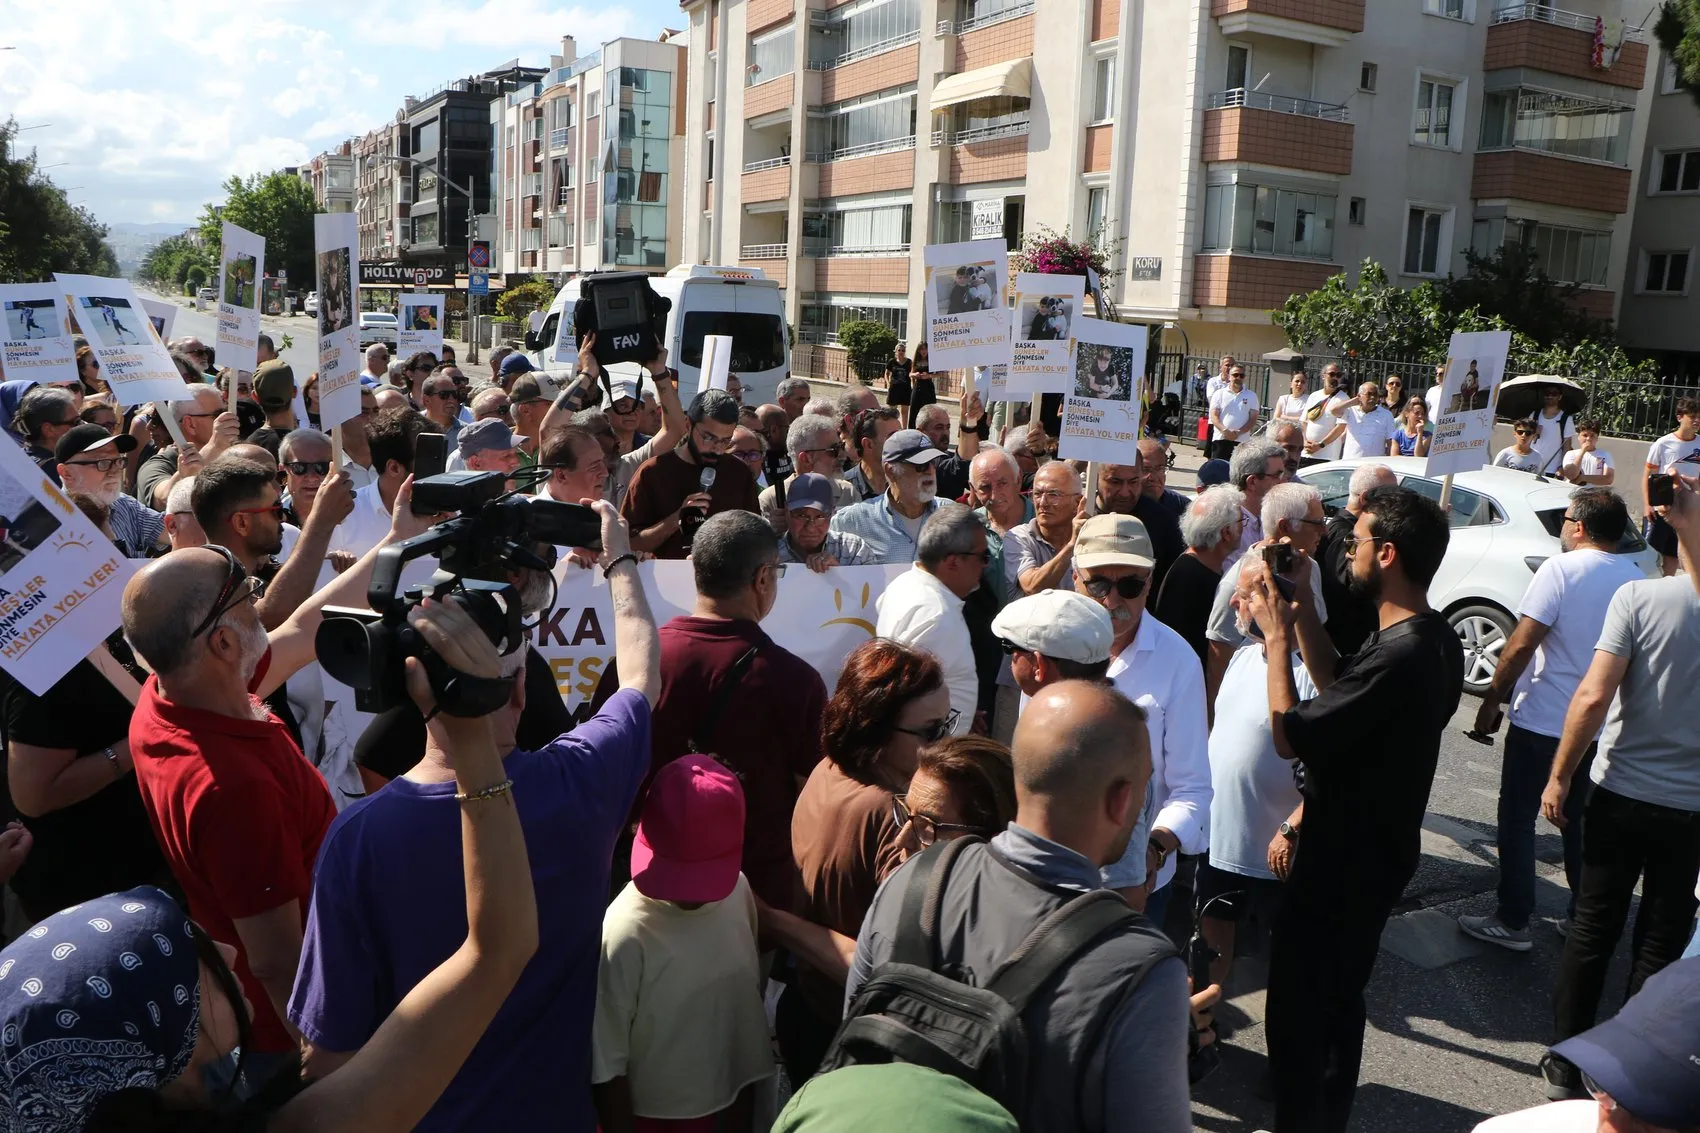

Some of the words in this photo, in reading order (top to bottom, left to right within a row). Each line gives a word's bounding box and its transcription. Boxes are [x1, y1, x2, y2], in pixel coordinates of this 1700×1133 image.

[1135, 257, 1160, 269] KORU
[418, 274, 425, 283] D
[933, 316, 959, 325] BAŞKA
[612, 333, 640, 350] FAV
[934, 340, 966, 349] HAYATA
[1068, 398, 1091, 408] BAŞKA
[1067, 413, 1100, 423] SÖNMESİN
[1065, 426, 1095, 436] HAYATA
[1097, 430, 1113, 438] YOL
[1115, 432, 1134, 440] VER!
[1, 612, 57, 659] HAYATA
[54, 590, 87, 613] YOL
[83, 558, 120, 588] VER!
